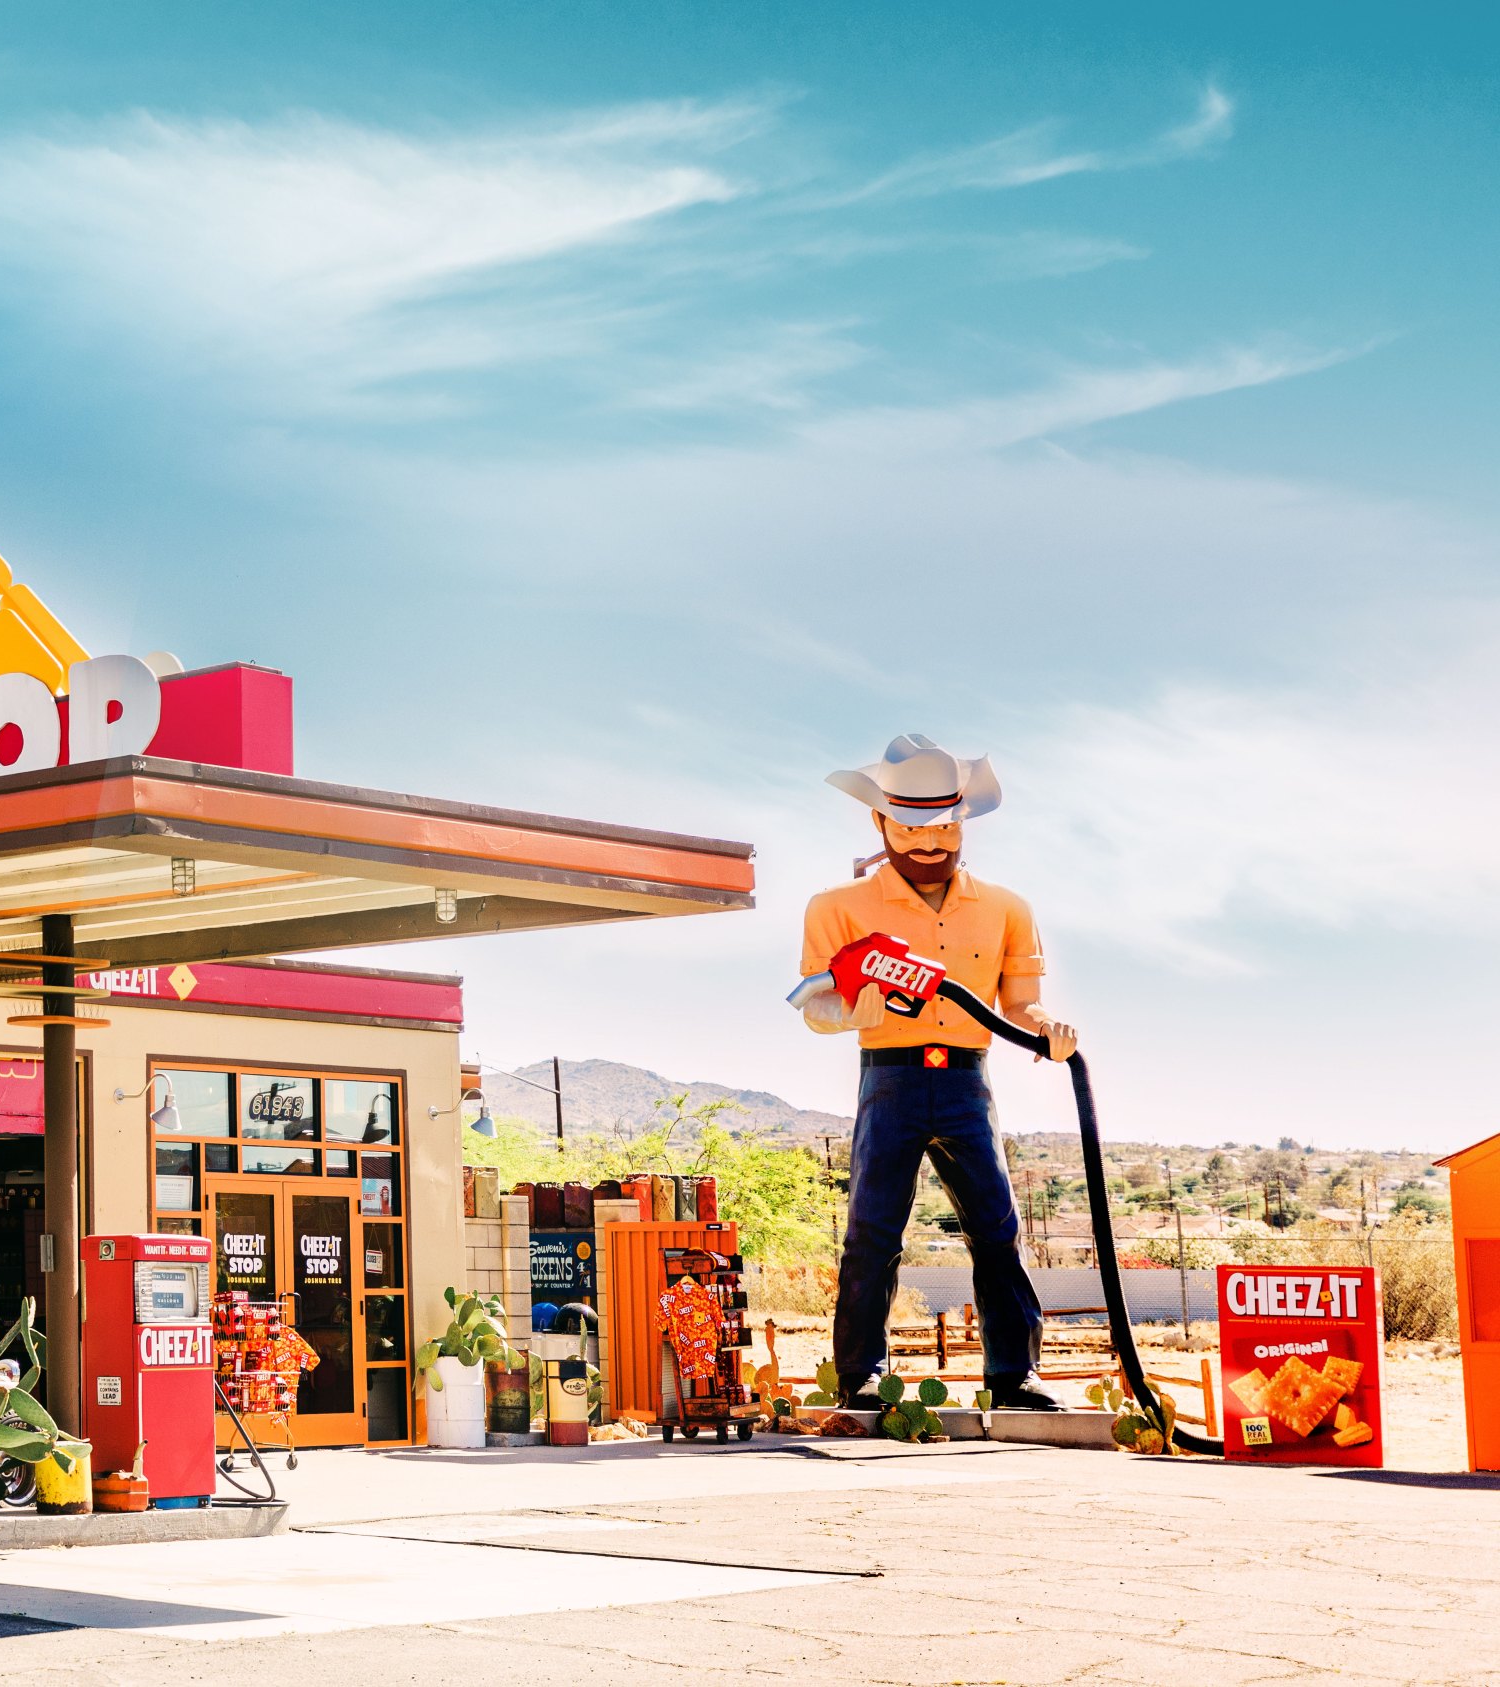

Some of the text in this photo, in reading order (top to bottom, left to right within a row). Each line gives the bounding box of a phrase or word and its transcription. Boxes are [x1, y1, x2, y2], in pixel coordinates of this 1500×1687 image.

[861, 949, 936, 994] CHEEZ-IT
[251, 1094, 304, 1118] 61943
[144, 1245, 161, 1255] WANT
[530, 1241, 568, 1256] Souvenir
[229, 1257, 262, 1273] STOP
[306, 1258, 339, 1274] STOP
[531, 1256, 573, 1280] OKENS
[1226, 1272, 1363, 1318] CHEEZ-IT
[140, 1327, 213, 1365] CHEEZ-IT
